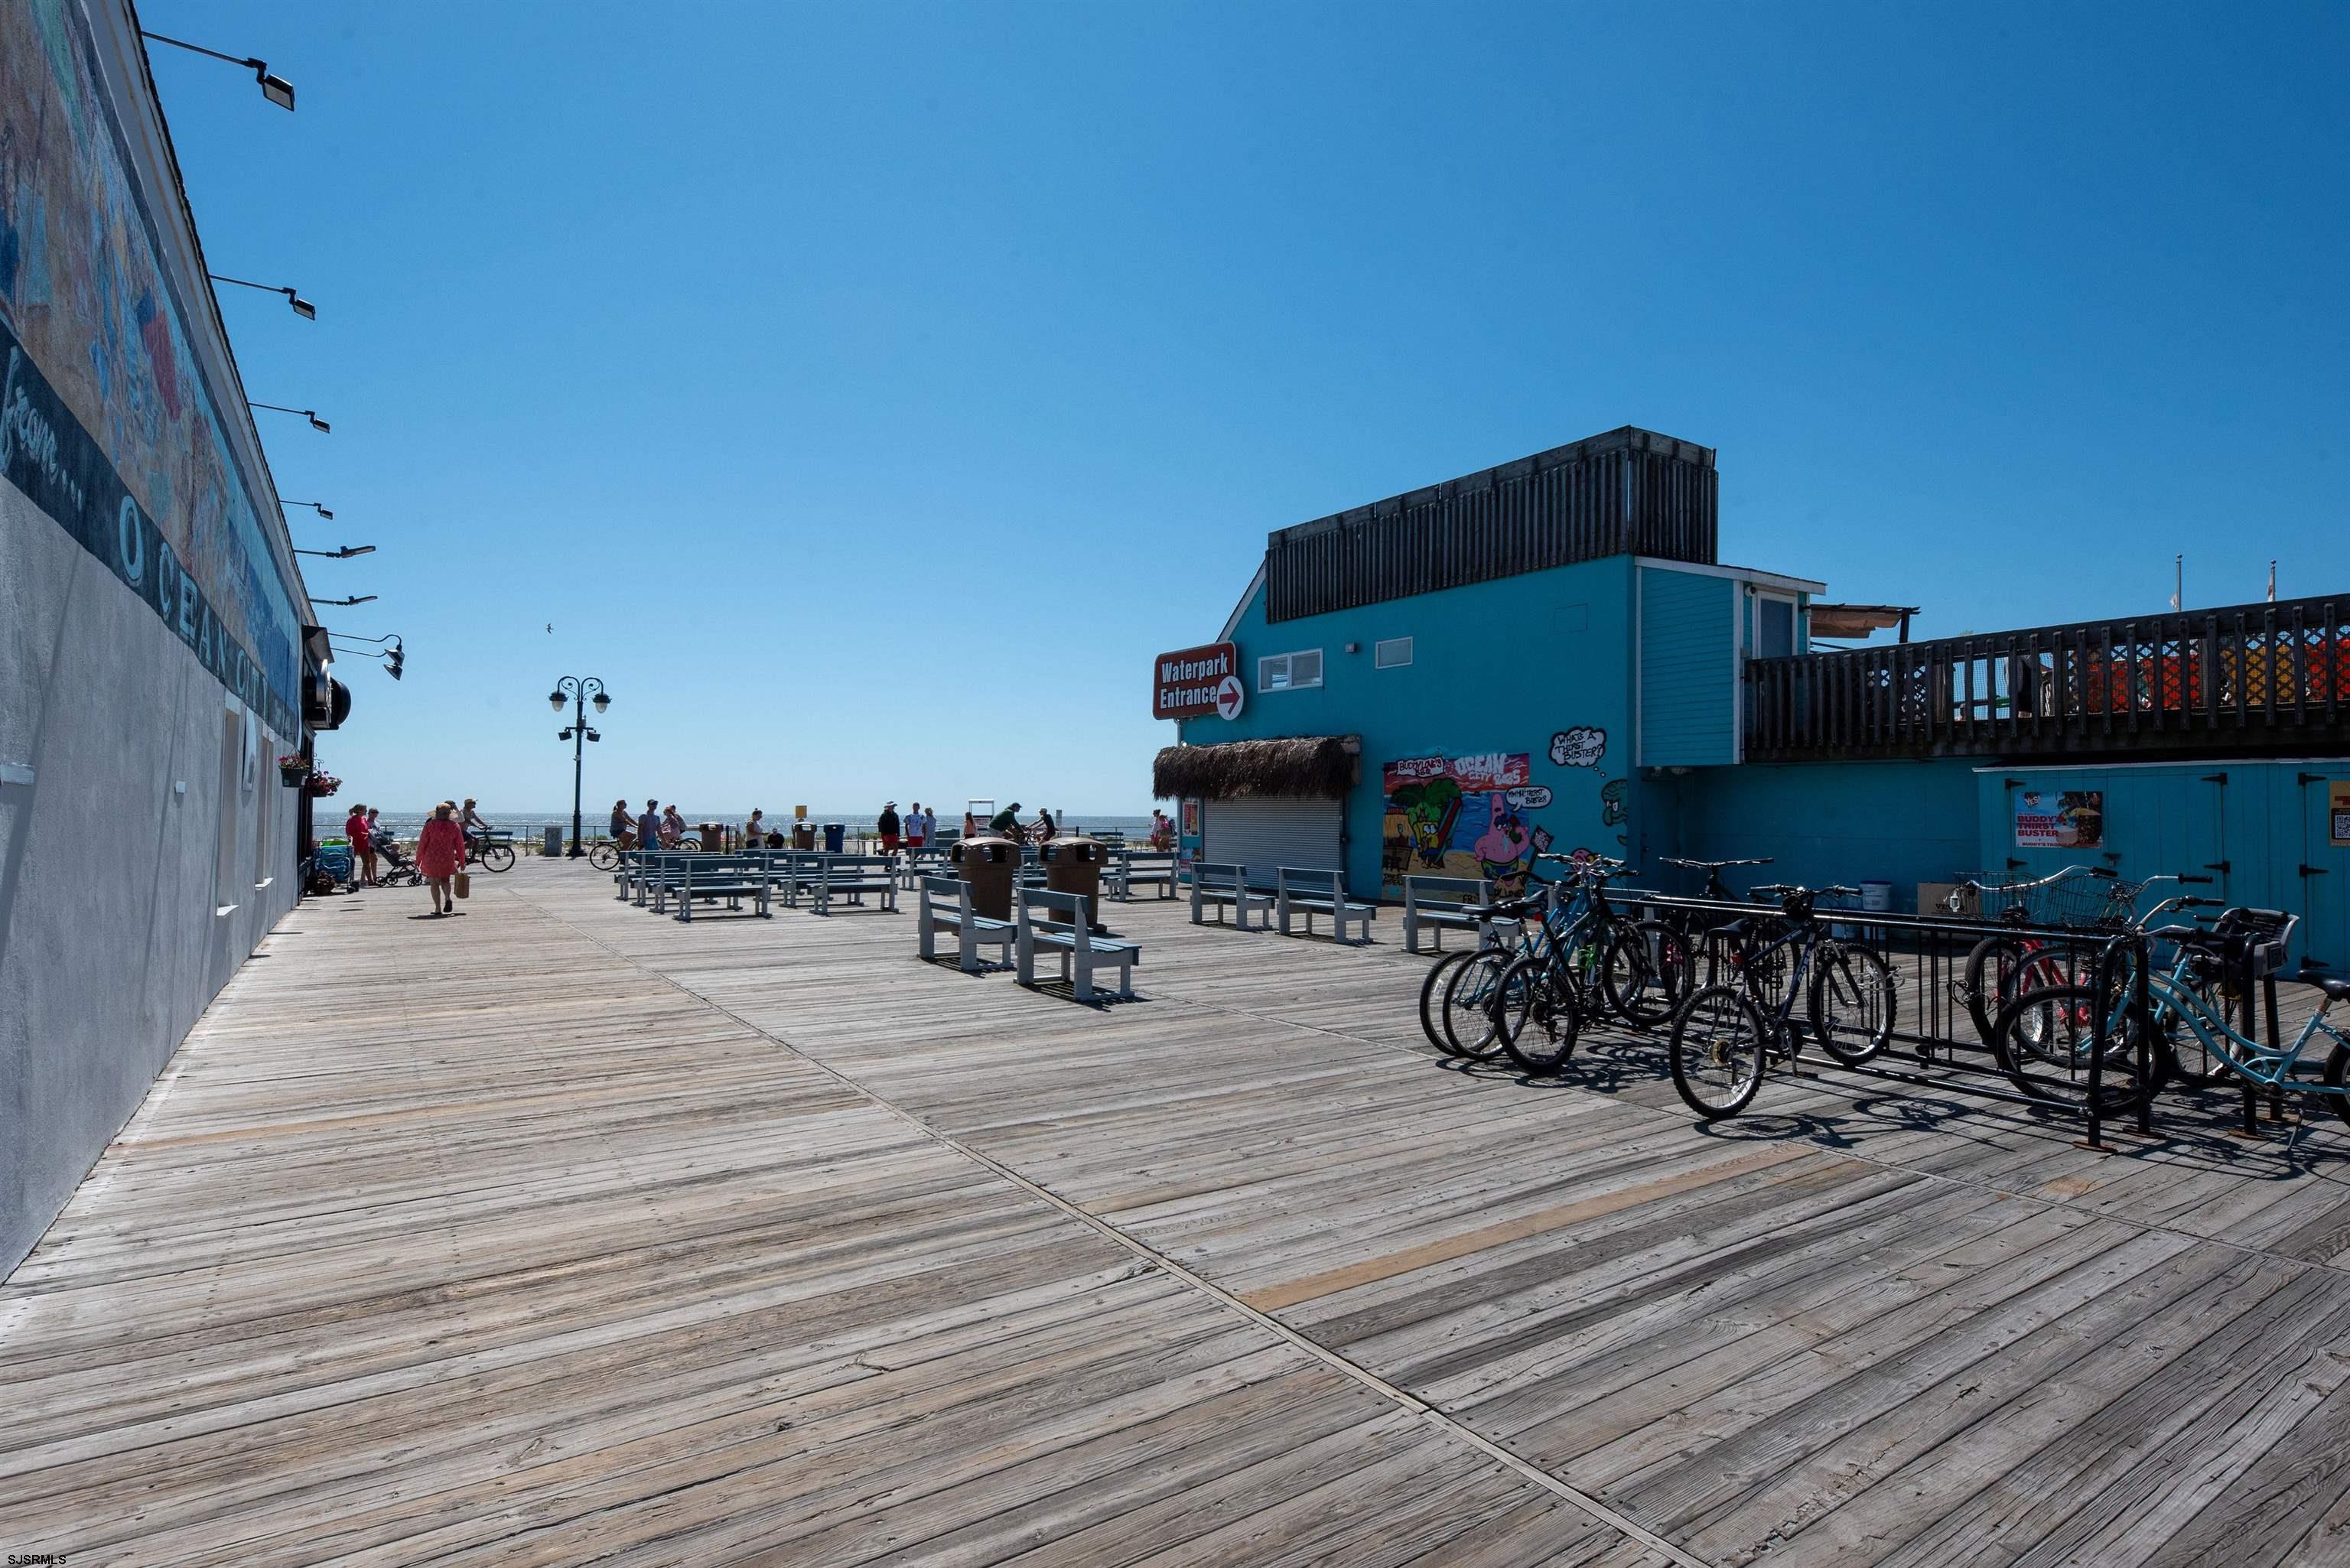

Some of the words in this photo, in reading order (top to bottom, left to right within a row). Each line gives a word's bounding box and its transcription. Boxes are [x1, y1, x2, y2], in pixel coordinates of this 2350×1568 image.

[119, 495, 227, 678] OCEAN
[236, 649, 269, 721] CITY
[1161, 652, 1229, 684] Waterpark
[1160, 685, 1216, 709] Entrance
[1587, 732, 1597, 740] A
[1554, 740, 1586, 753] THIRST
[1562, 744, 1603, 760] BUSTER?
[1454, 753, 1506, 776] OCEAN
[1469, 771, 1492, 782] CITY
